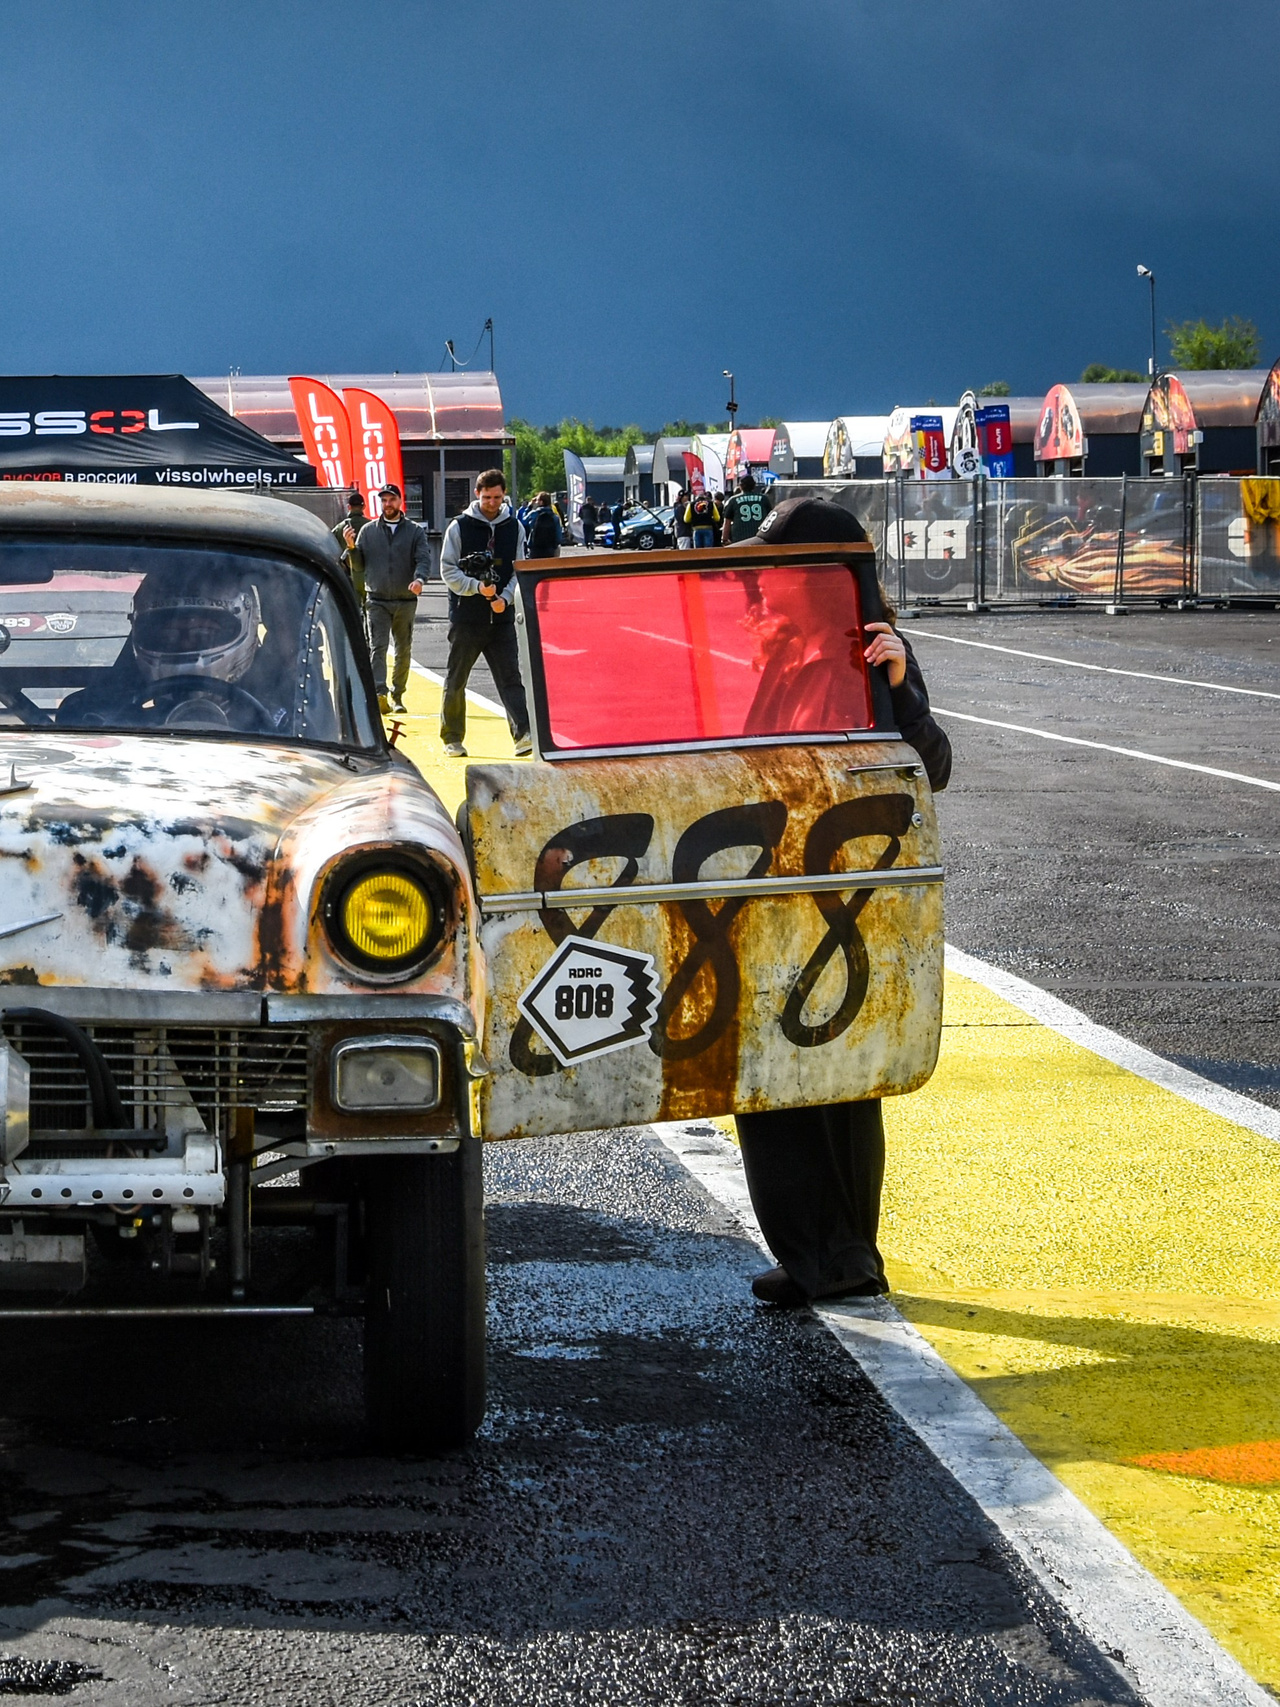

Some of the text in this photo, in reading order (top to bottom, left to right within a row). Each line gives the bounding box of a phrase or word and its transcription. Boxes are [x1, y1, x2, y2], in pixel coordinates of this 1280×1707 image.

[65, 473, 74, 483] В
[77, 472, 137, 484] РОССИИ
[156, 468, 297, 483] vissolwheels.ru
[740, 503, 762, 522] 99
[568, 967, 603, 979] RDRC
[554, 984, 614, 1020] 808
